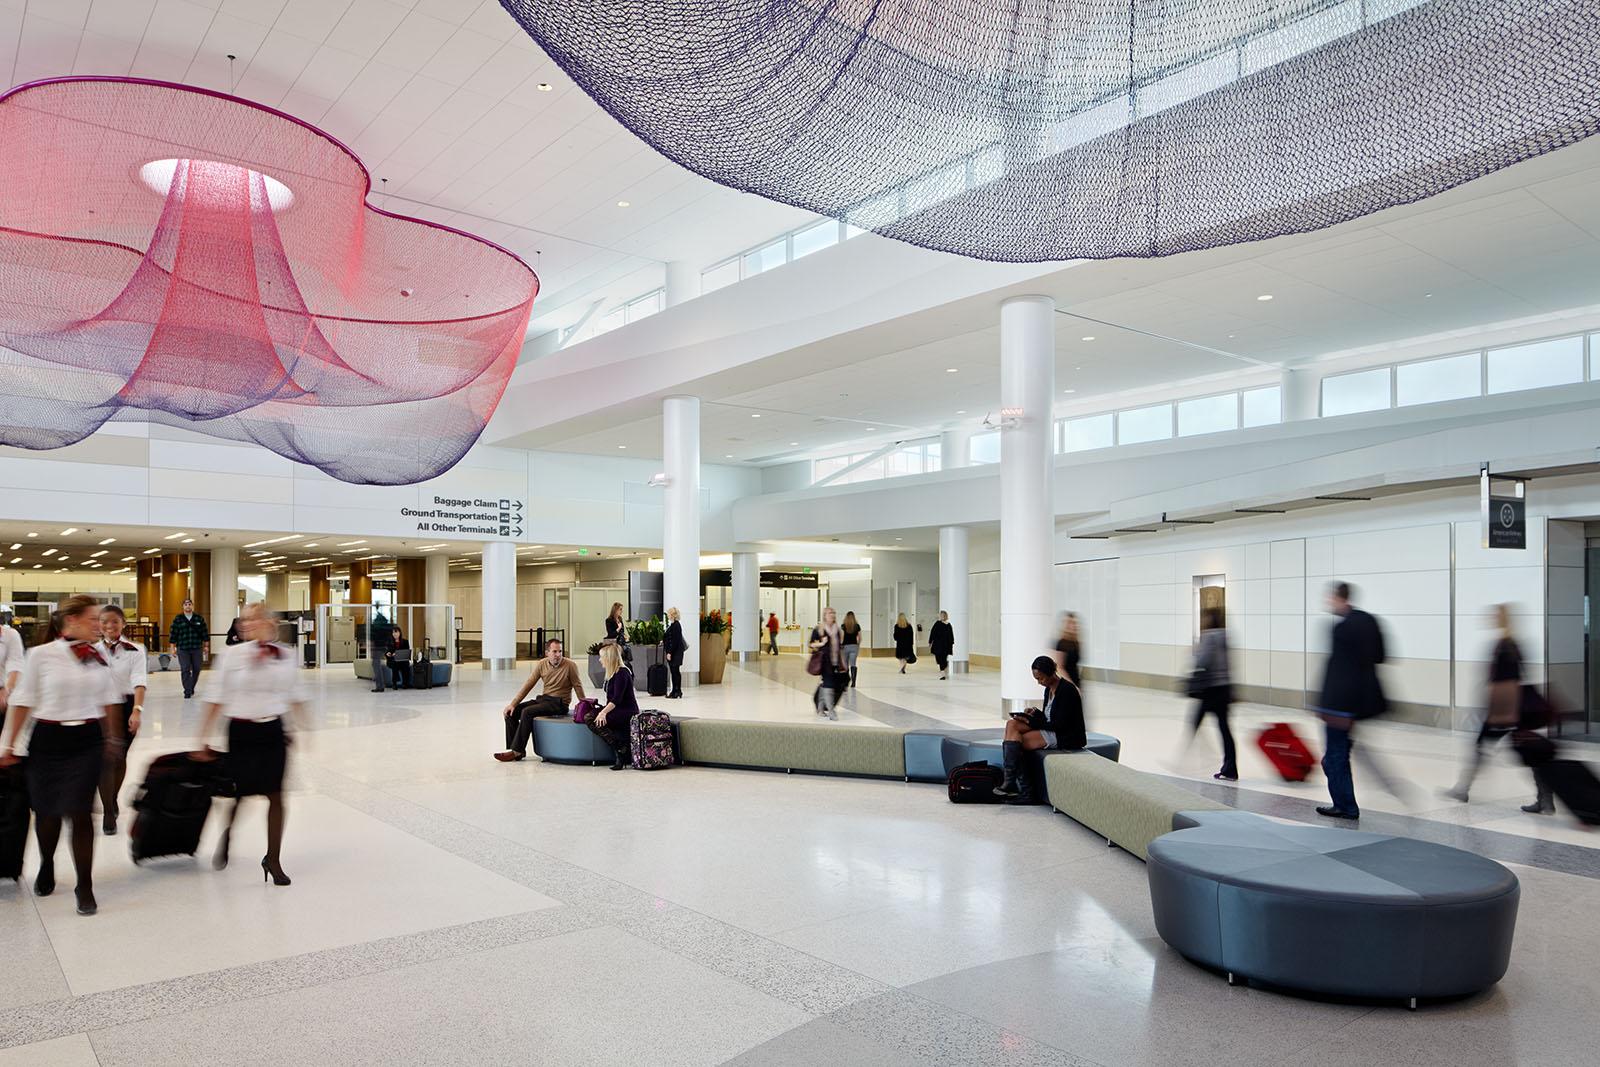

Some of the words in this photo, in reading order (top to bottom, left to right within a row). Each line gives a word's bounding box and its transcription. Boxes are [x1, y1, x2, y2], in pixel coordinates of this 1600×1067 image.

[434, 496, 472, 508] Baggage
[474, 499, 498, 508] Claim
[400, 508, 435, 518] Ground
[436, 510, 498, 520] Transportation
[417, 522, 430, 530] All
[432, 523, 456, 532] Other
[457, 524, 498, 534] Terminals
